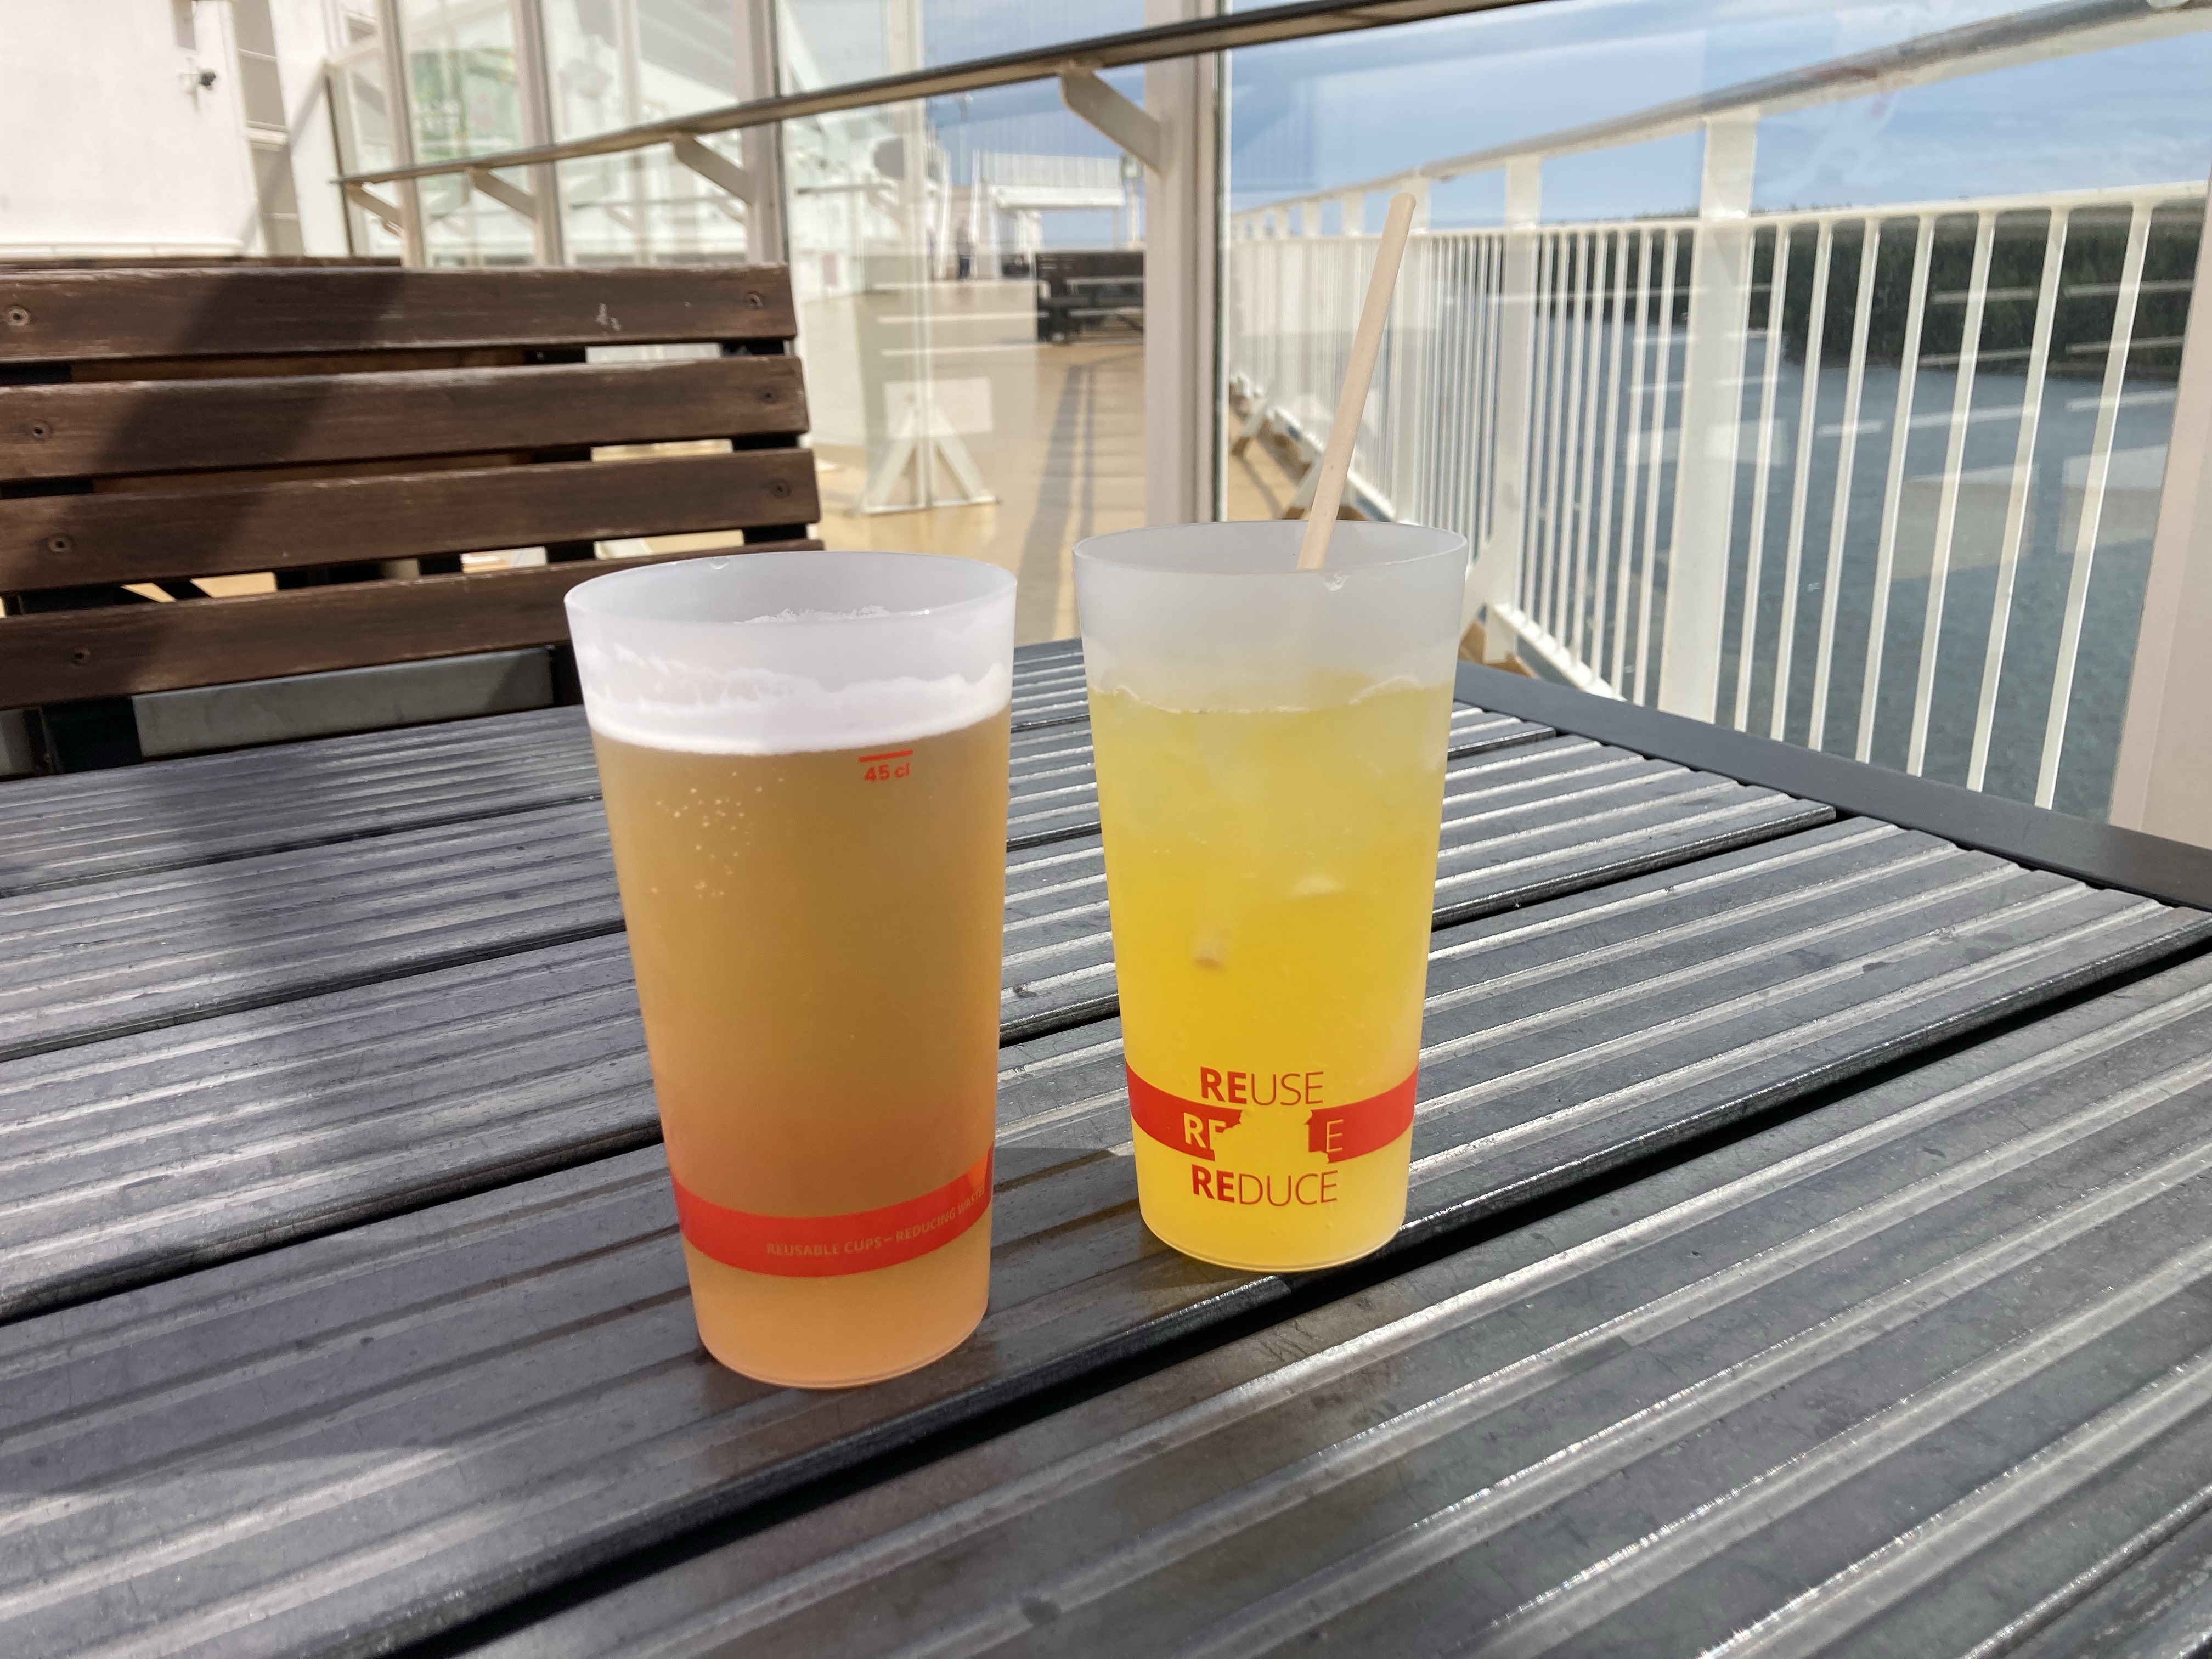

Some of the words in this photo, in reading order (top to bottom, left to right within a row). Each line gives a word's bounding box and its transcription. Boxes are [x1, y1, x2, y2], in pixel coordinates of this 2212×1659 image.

[864, 764, 890, 782] 45
[894, 761, 910, 778] cl
[1200, 1066, 1324, 1105] REUSE
[1191, 1163, 1338, 1206] REDUCE
[766, 1242, 840, 1256] REUSABLE
[896, 1207, 956, 1242] REDUCING
